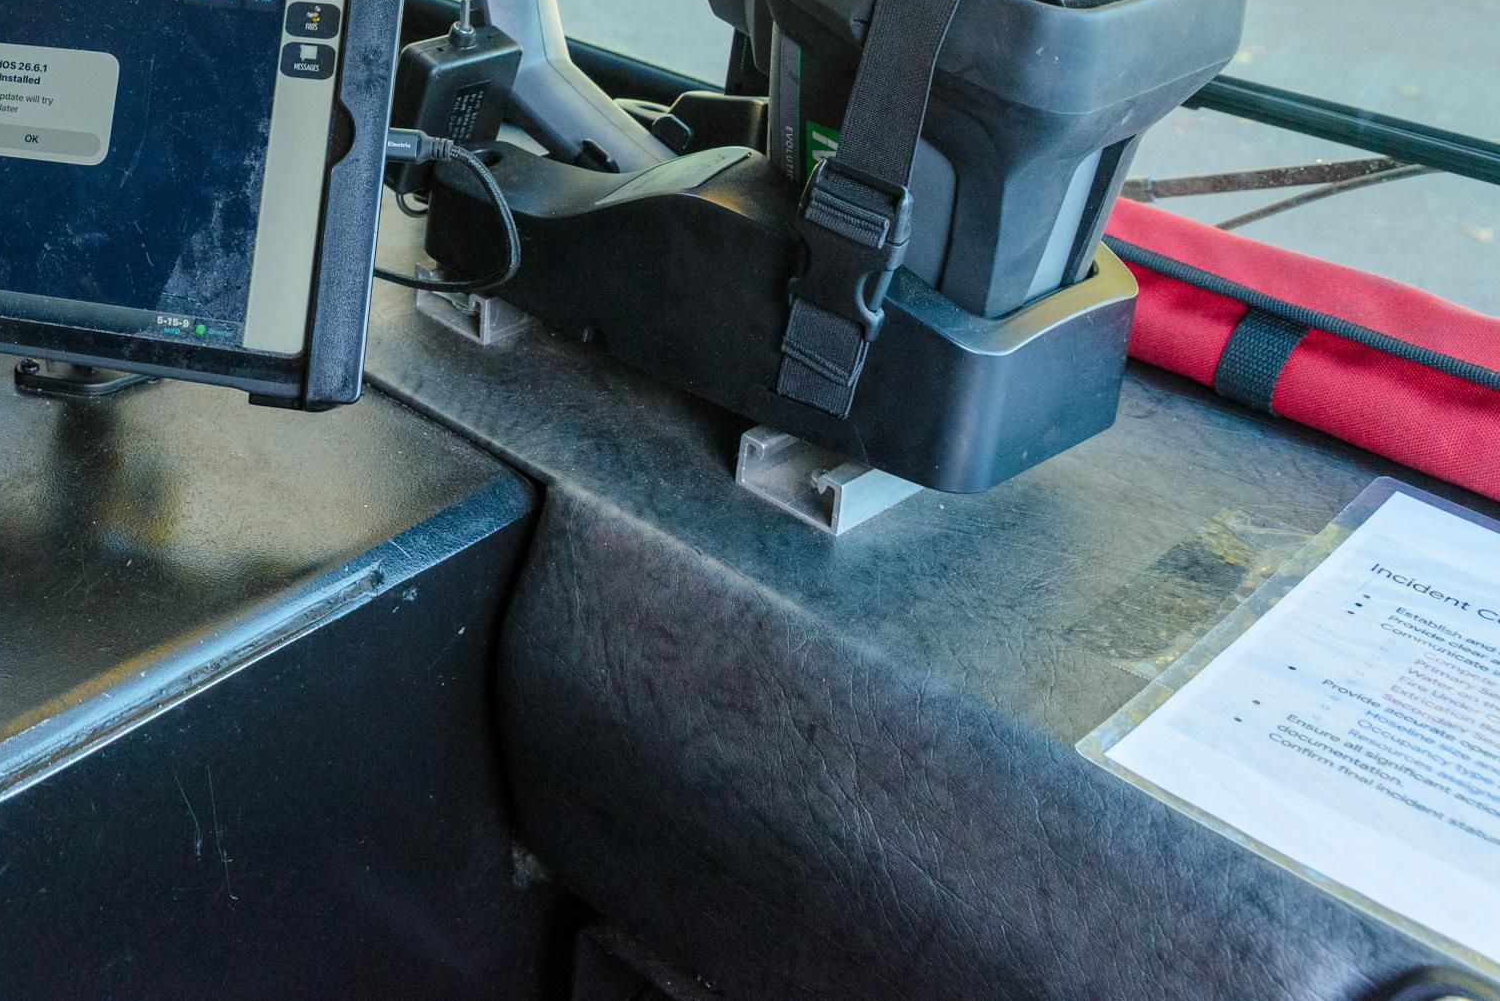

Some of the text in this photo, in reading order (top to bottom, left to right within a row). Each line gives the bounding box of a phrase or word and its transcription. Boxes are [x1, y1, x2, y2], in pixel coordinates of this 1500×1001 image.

[18, 62, 48, 73] 26.6.1
[294, 63, 320, 72] MESSAGES
[0, 103, 18, 114] later
[26, 94, 40, 104] will
[41, 96, 54, 106] try
[24, 134, 40, 144] OK
[156, 316, 190, 328] 5-15-9
[1370, 563, 1472, 611] Incident
[1380, 622, 1490, 673] Communicate
[1387, 615, 1445, 643] Provide
[1448, 641, 1489, 660] clear
[1395, 606, 1498, 653] Establish and
[1398, 675, 1428, 693] Fire
[1432, 689, 1481, 714] Under
[1407, 666, 1454, 691] Water
[1457, 690, 1480, 702] on
[1414, 658, 1476, 690] Primary
[1321, 678, 1382, 709] Provide
[1384, 706, 1457, 741] accurate
[1381, 693, 1470, 733] Secondary
[1389, 684, 1476, 724] Extrication
[1276, 724, 1404, 787] documentation.
[1286, 713, 1341, 743] Ensure
[1343, 740, 1364, 753] all
[1364, 749, 1453, 794] significant
[1347, 728, 1434, 772] Resources
[1357, 718, 1494, 785] Occupancy type
[1364, 709, 1436, 745] Hoseline
[1438, 742, 1472, 761] size
[1268, 731, 1335, 768] Confirm
[1337, 764, 1375, 787] final
[1375, 782, 1446, 820] incident
